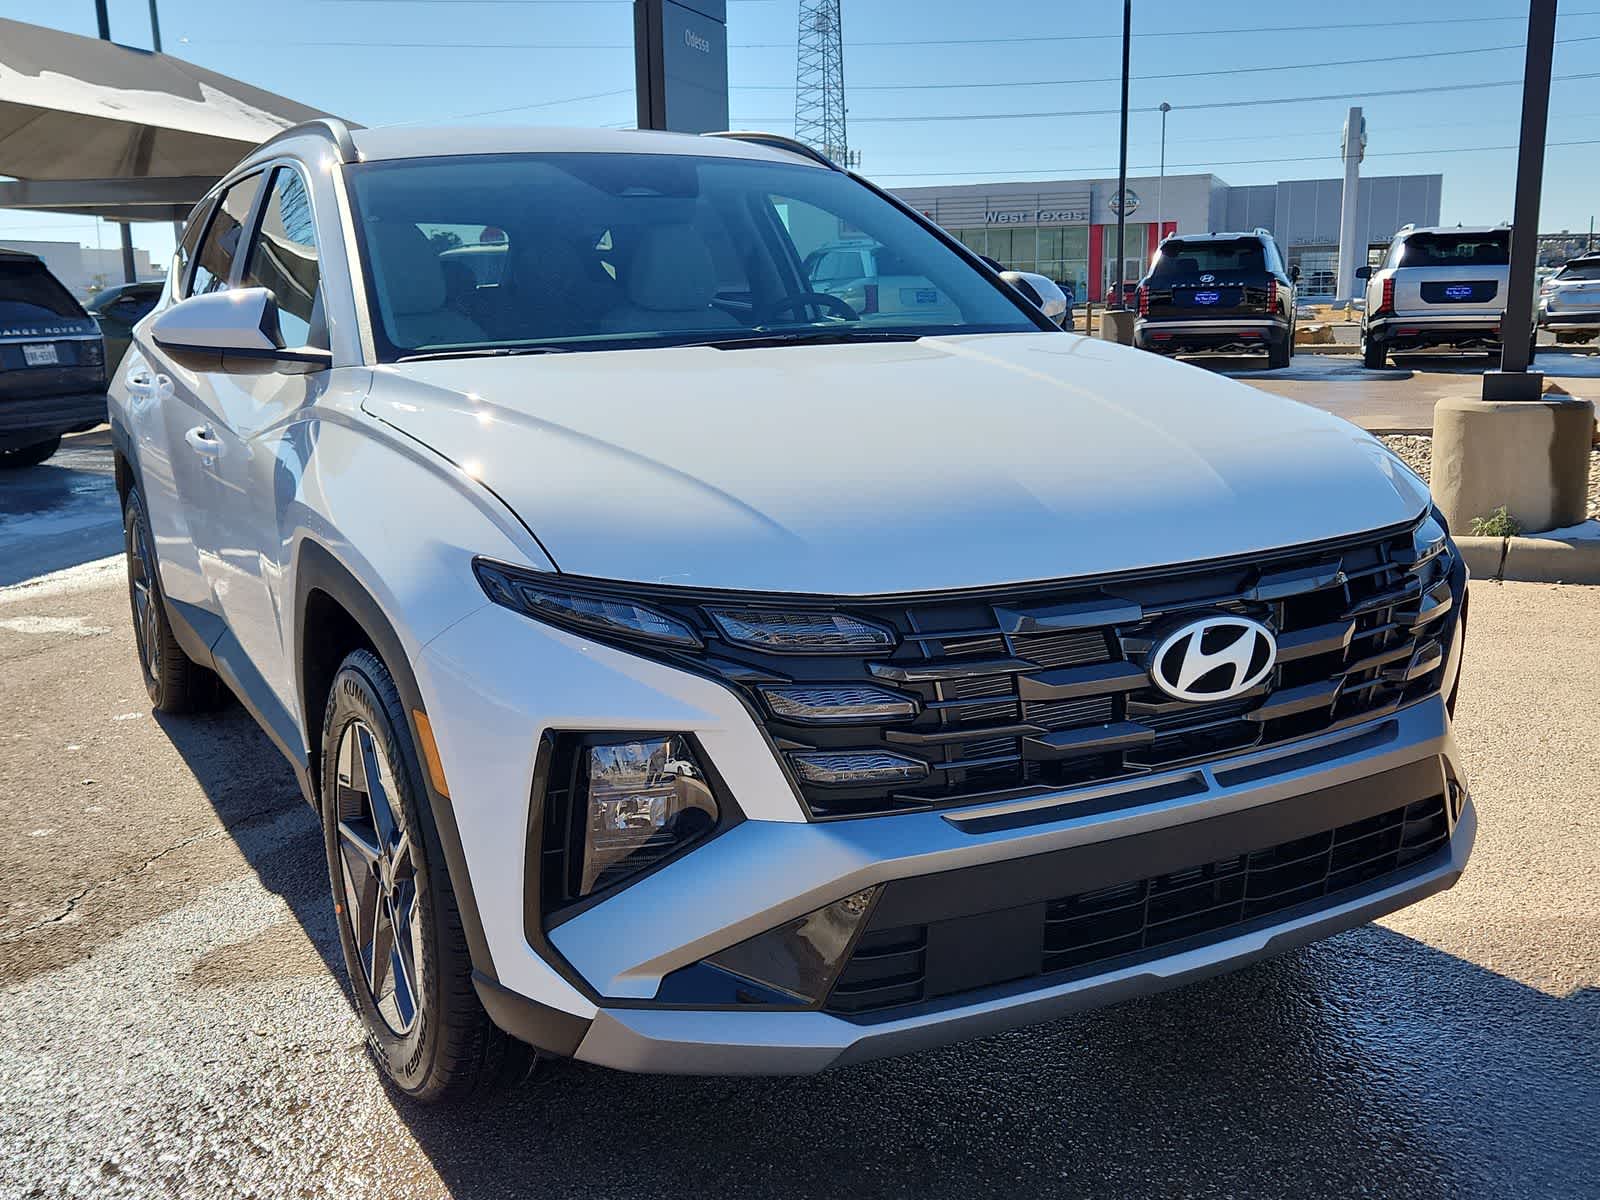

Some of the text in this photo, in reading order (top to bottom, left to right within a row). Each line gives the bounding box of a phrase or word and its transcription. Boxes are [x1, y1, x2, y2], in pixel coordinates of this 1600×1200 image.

[684, 29, 710, 53] Odessa
[983, 208, 1082, 224] West Texas
[0, 326, 82, 336] ANGE ROVER
